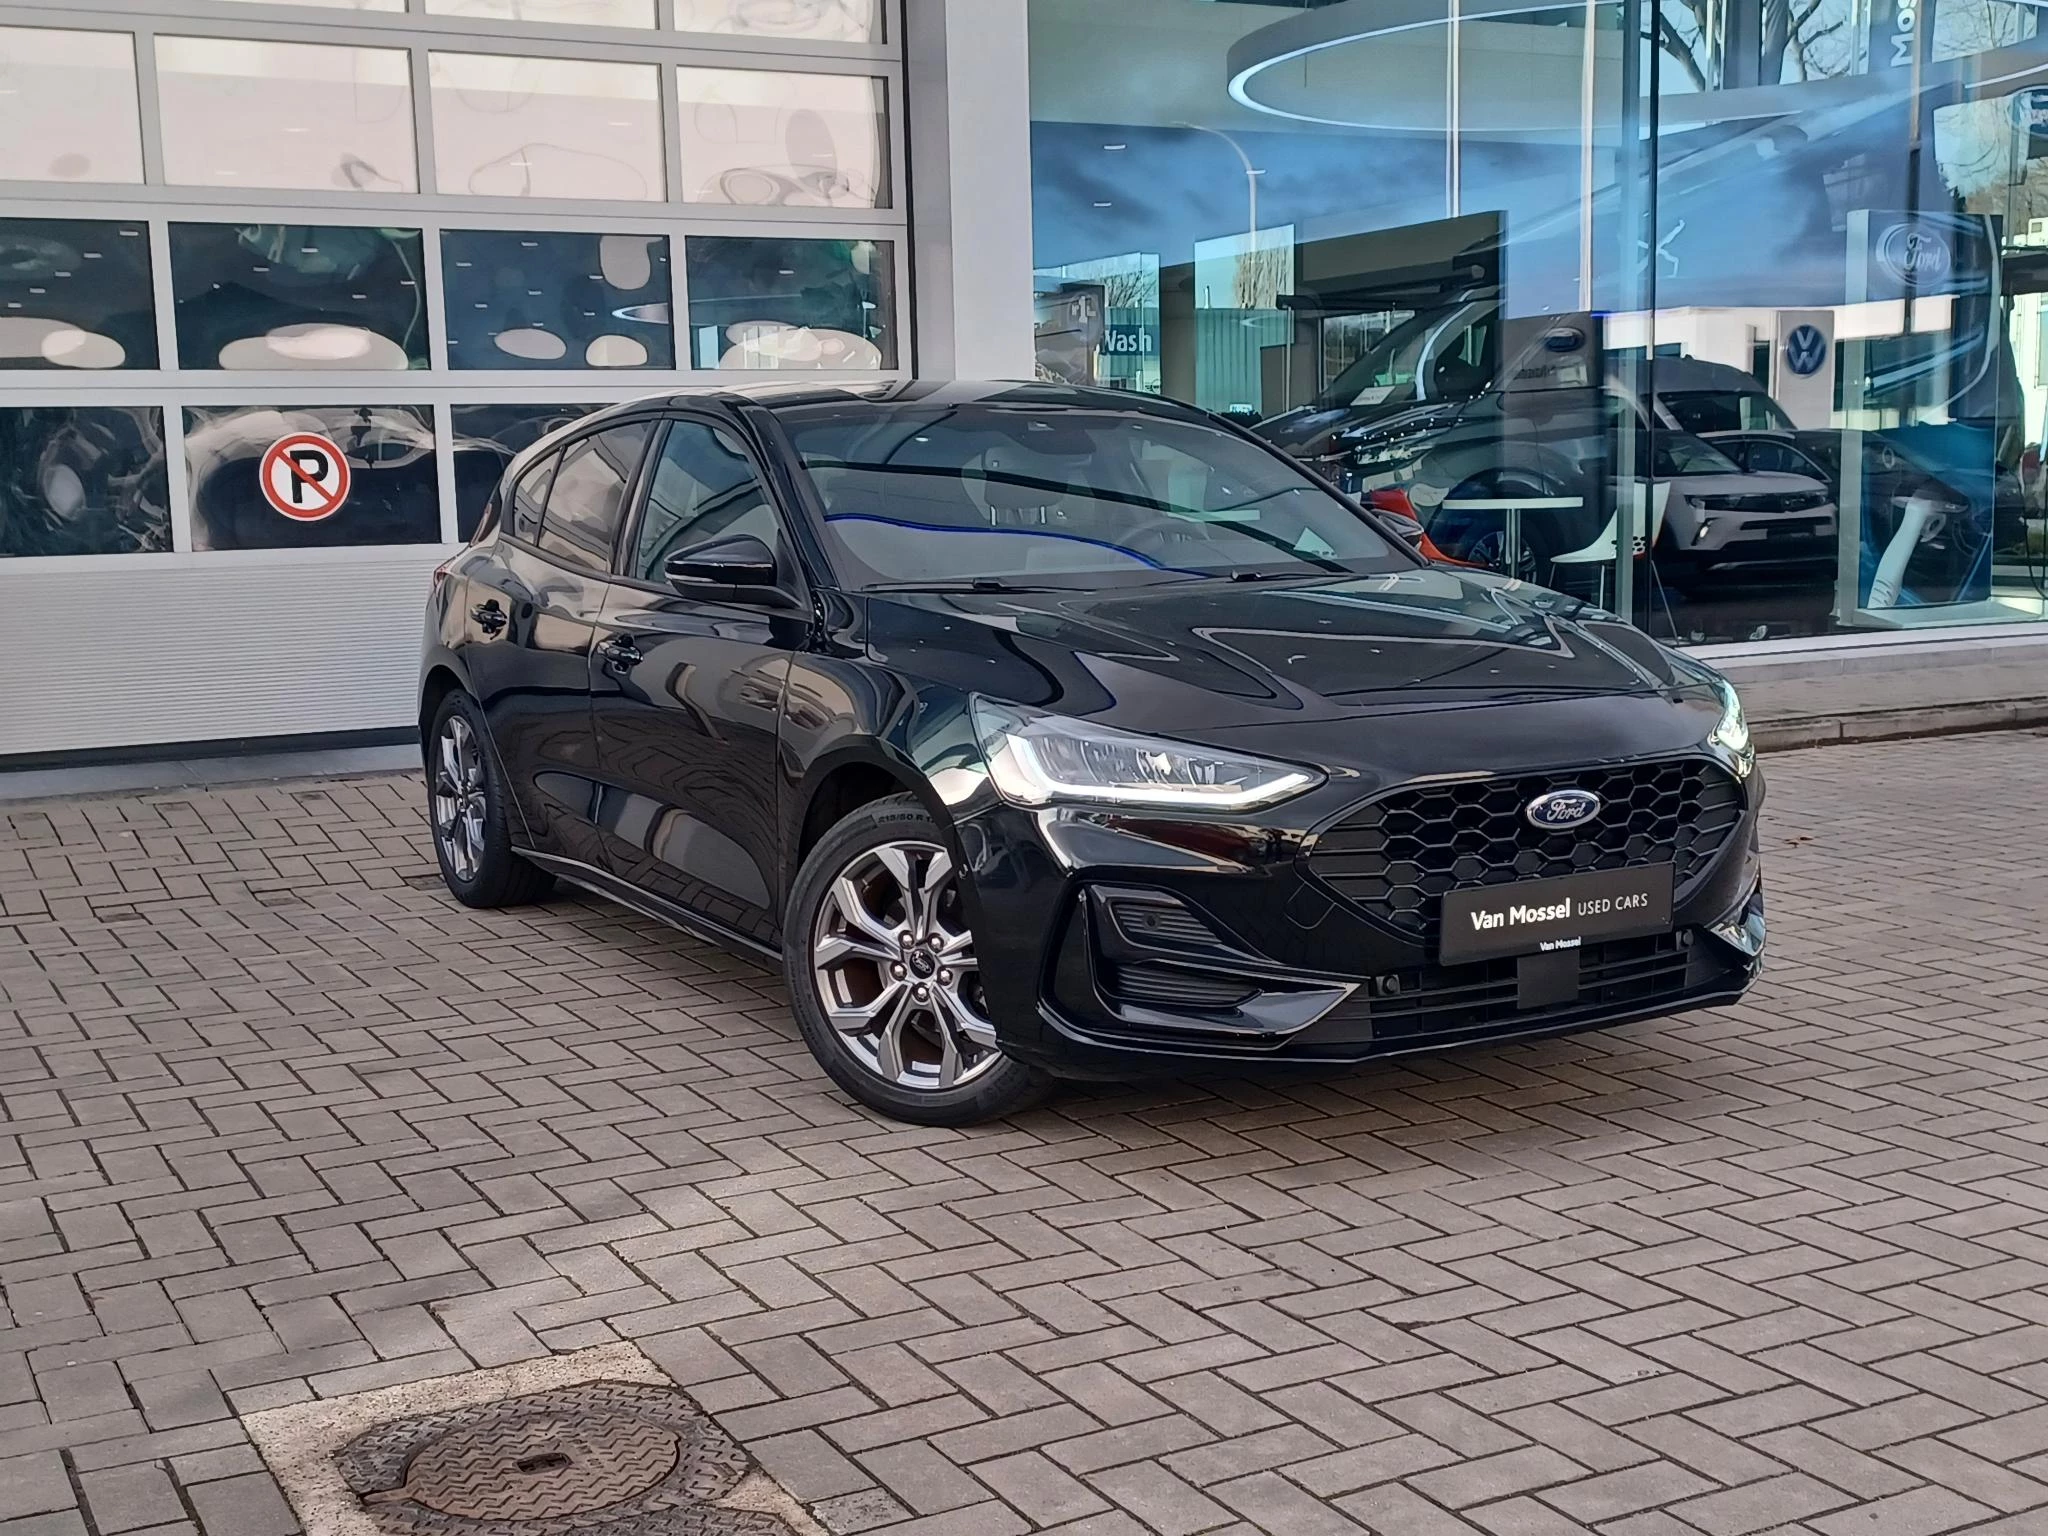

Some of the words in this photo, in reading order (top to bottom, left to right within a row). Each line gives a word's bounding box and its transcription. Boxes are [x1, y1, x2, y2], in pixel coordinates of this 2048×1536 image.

[1904, 233, 1941, 272] Ford
[1546, 798, 1586, 821] Ford
[1470, 910, 1505, 931] Van
[1509, 897, 1571, 926] Mossel
[1577, 898, 1611, 916] USED
[1615, 892, 1648, 911] CARS
[1539, 941, 1554, 952] Van
[1555, 936, 1582, 949] Mossel
